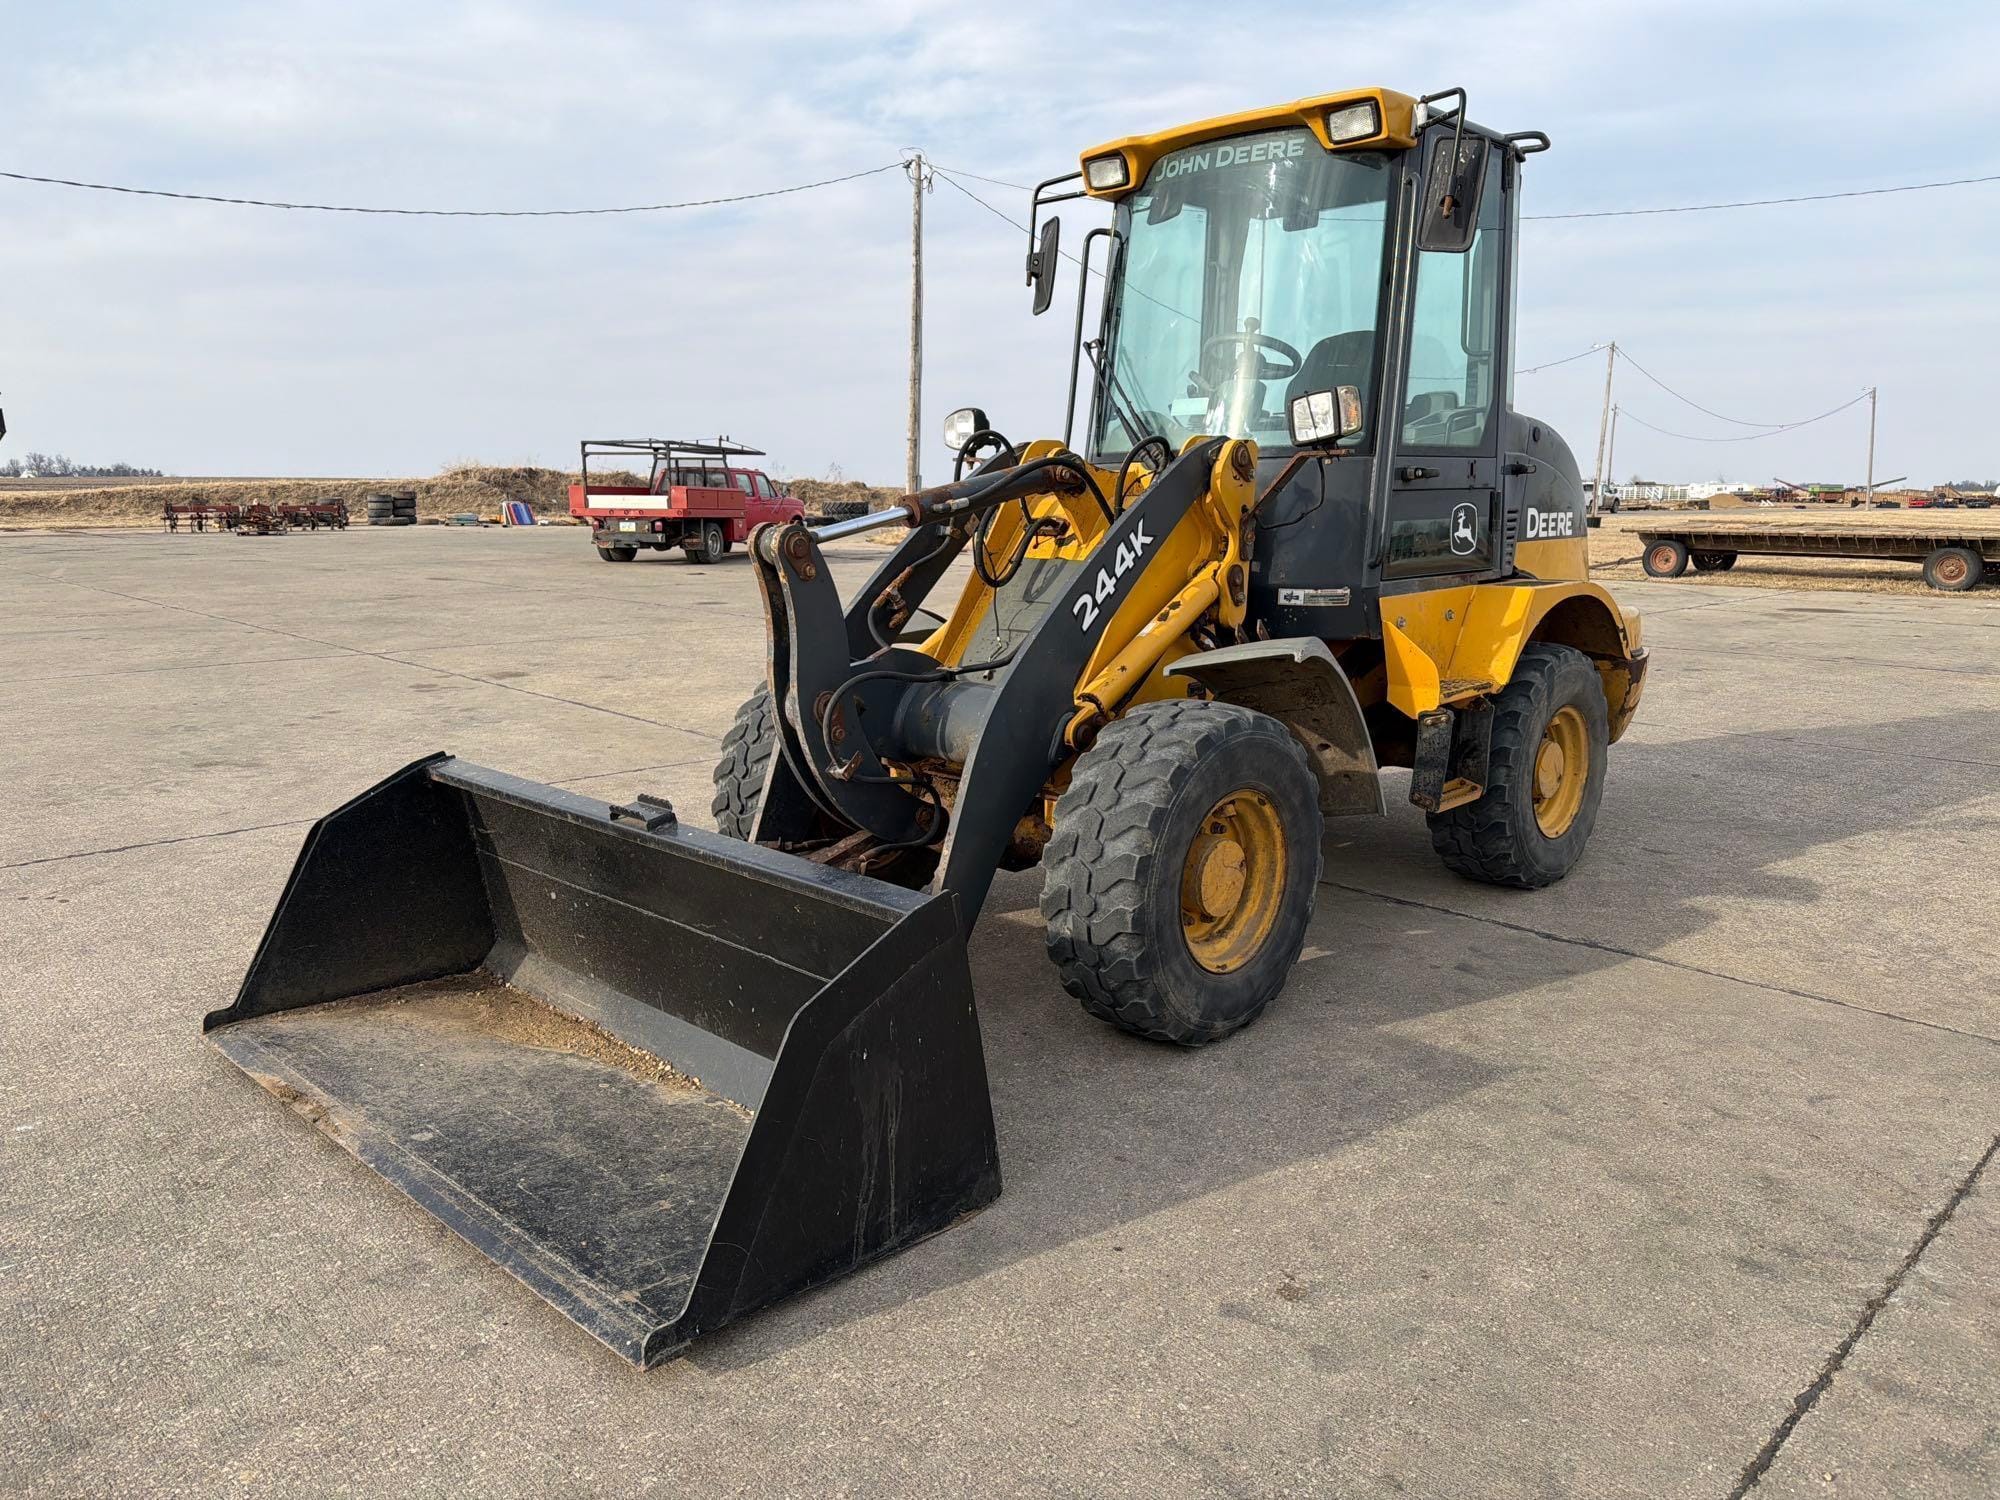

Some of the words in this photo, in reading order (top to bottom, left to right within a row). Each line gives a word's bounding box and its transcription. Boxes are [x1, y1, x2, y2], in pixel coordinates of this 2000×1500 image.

[1155, 152, 1210, 182] JOHN
[1215, 138, 1306, 168] DEERE
[1526, 507, 1573, 539] DEERE
[1072, 517, 1155, 632] 244K
